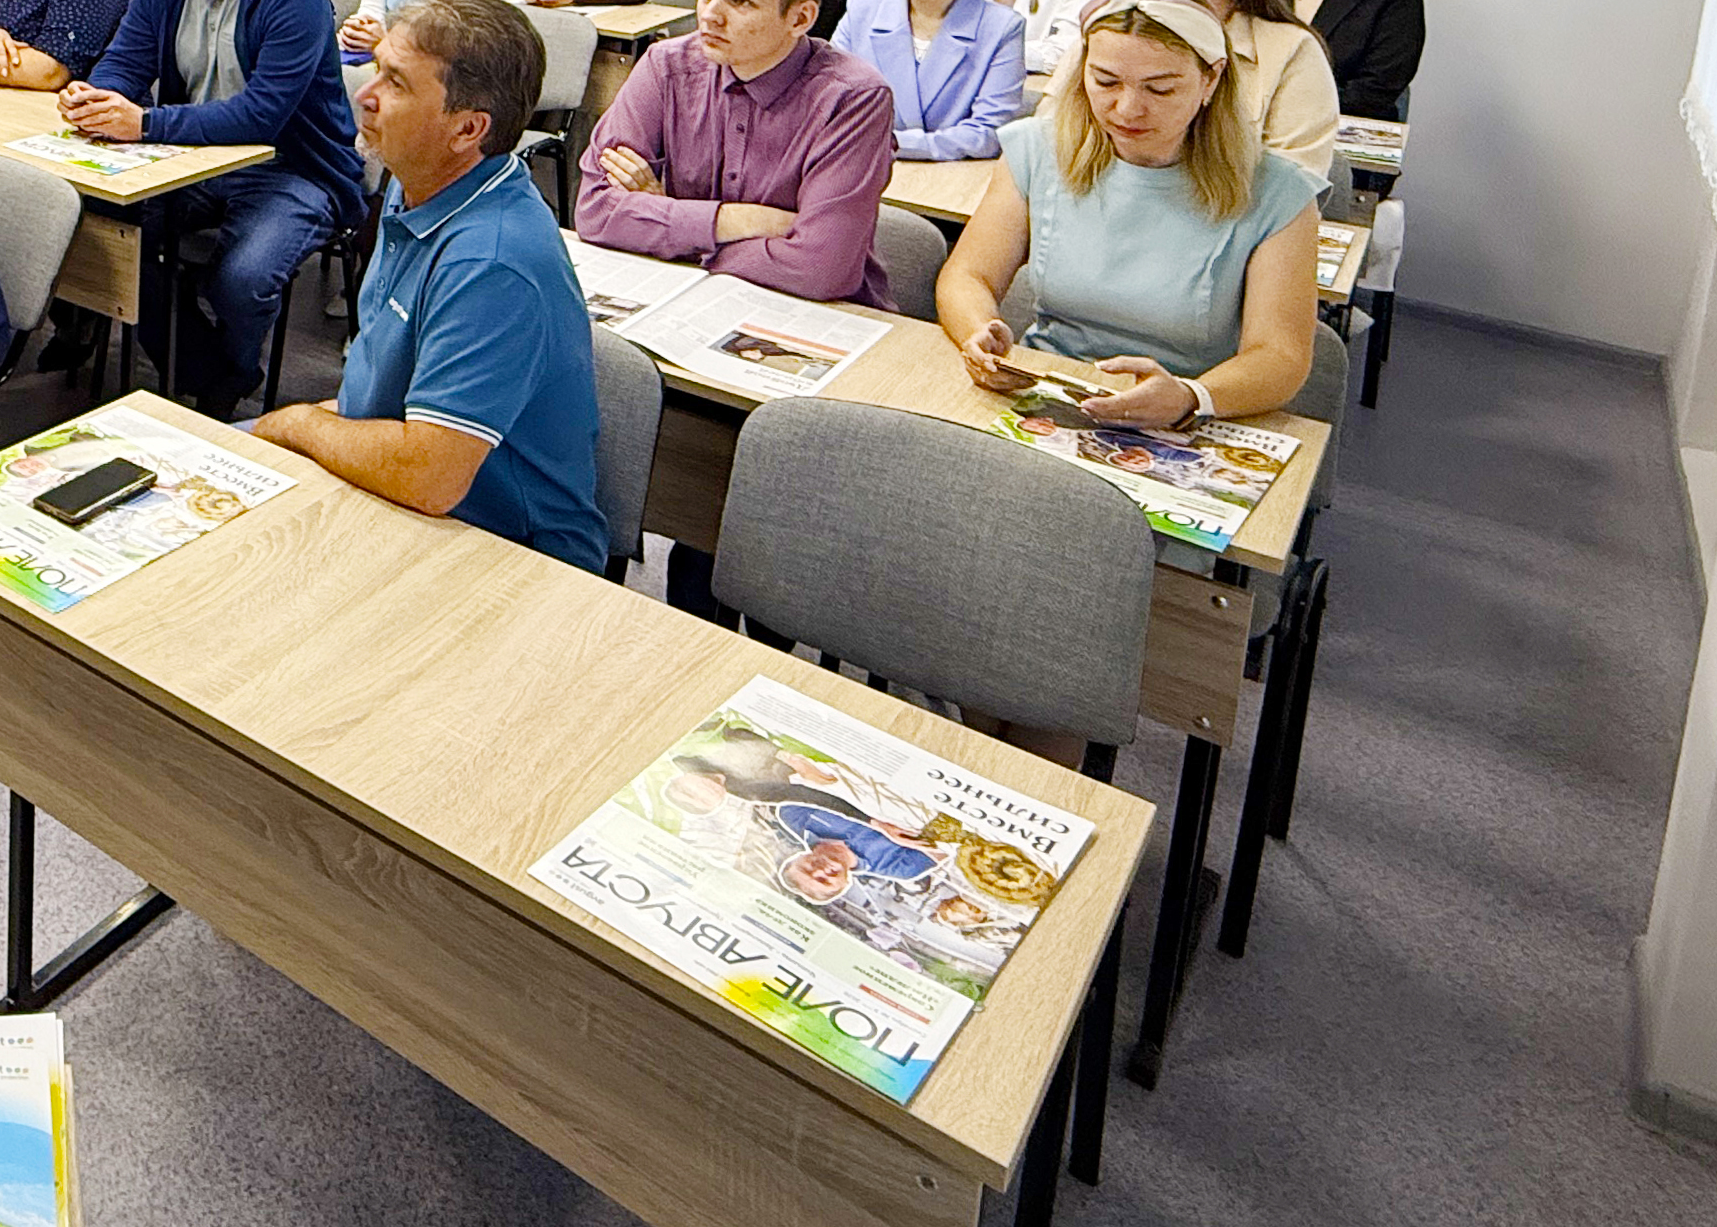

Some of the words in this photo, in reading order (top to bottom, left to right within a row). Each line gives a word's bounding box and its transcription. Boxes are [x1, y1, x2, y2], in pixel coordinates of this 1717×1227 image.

[1135, 500, 1223, 536] ПОЛ
[927, 769, 1070, 834] сильнее
[933, 792, 1058, 855] Вместе
[561, 845, 770, 965] АВГУСТА
[761, 964, 920, 1067] ПОЛЕ
